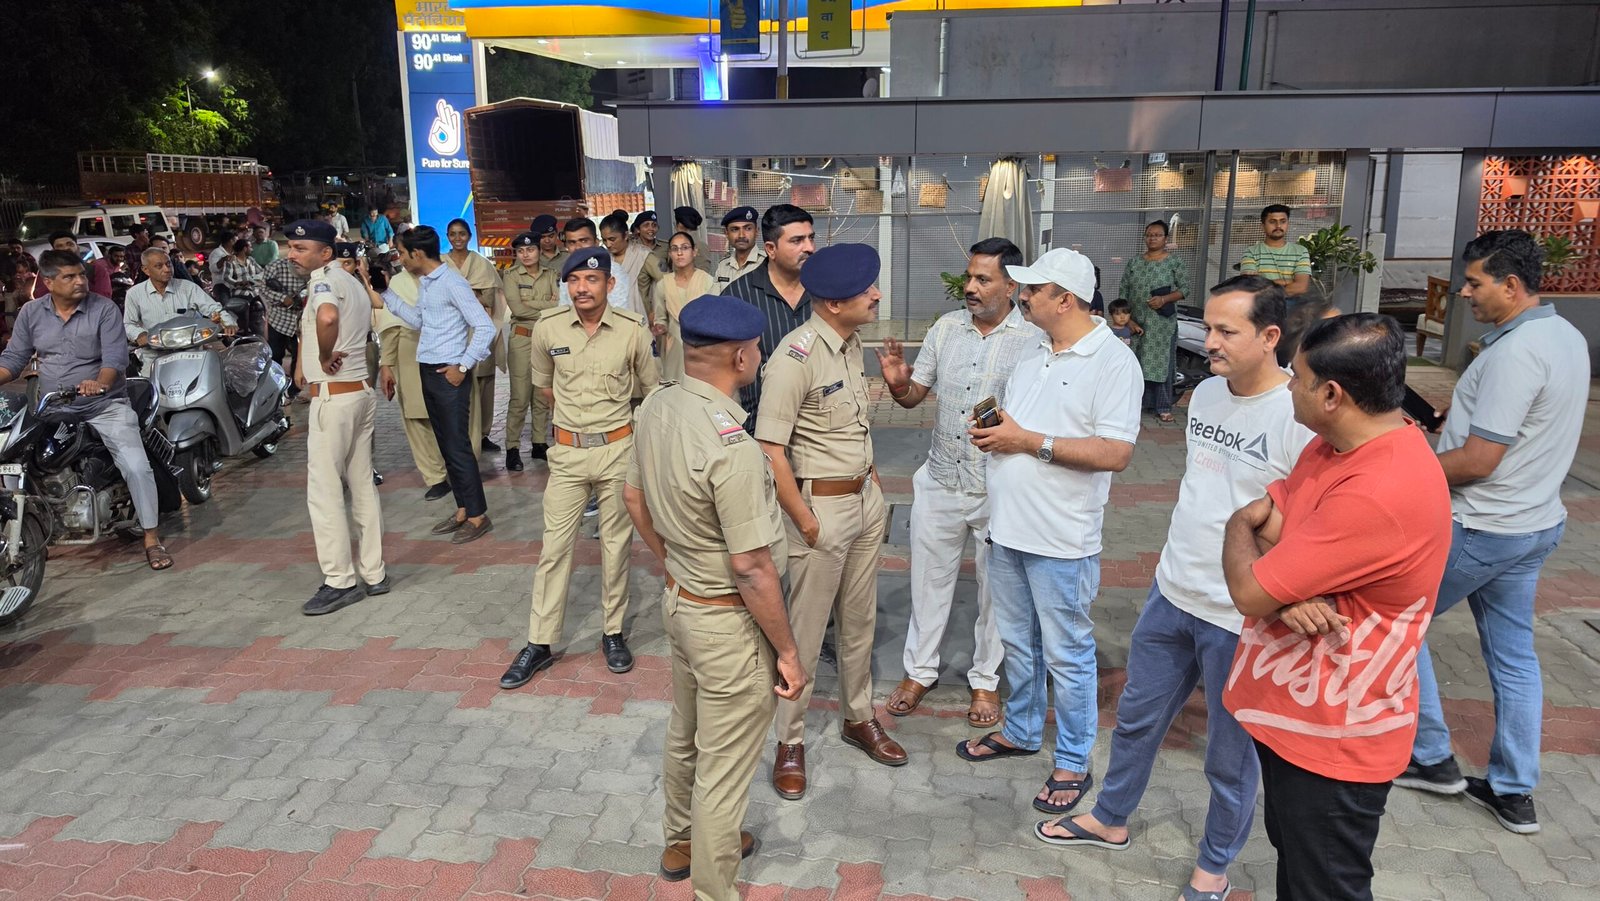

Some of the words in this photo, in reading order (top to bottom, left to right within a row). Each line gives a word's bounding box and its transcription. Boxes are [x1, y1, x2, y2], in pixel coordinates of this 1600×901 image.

[440, 33, 461, 42] Diesel
[442, 53, 463, 62] Diesel
[421, 157, 440, 168] Pure
[440, 158, 452, 168] for
[452, 158, 470, 169] Sure
[1190, 417, 1245, 451] Reebok
[1197, 440, 1218, 452] UNITED
